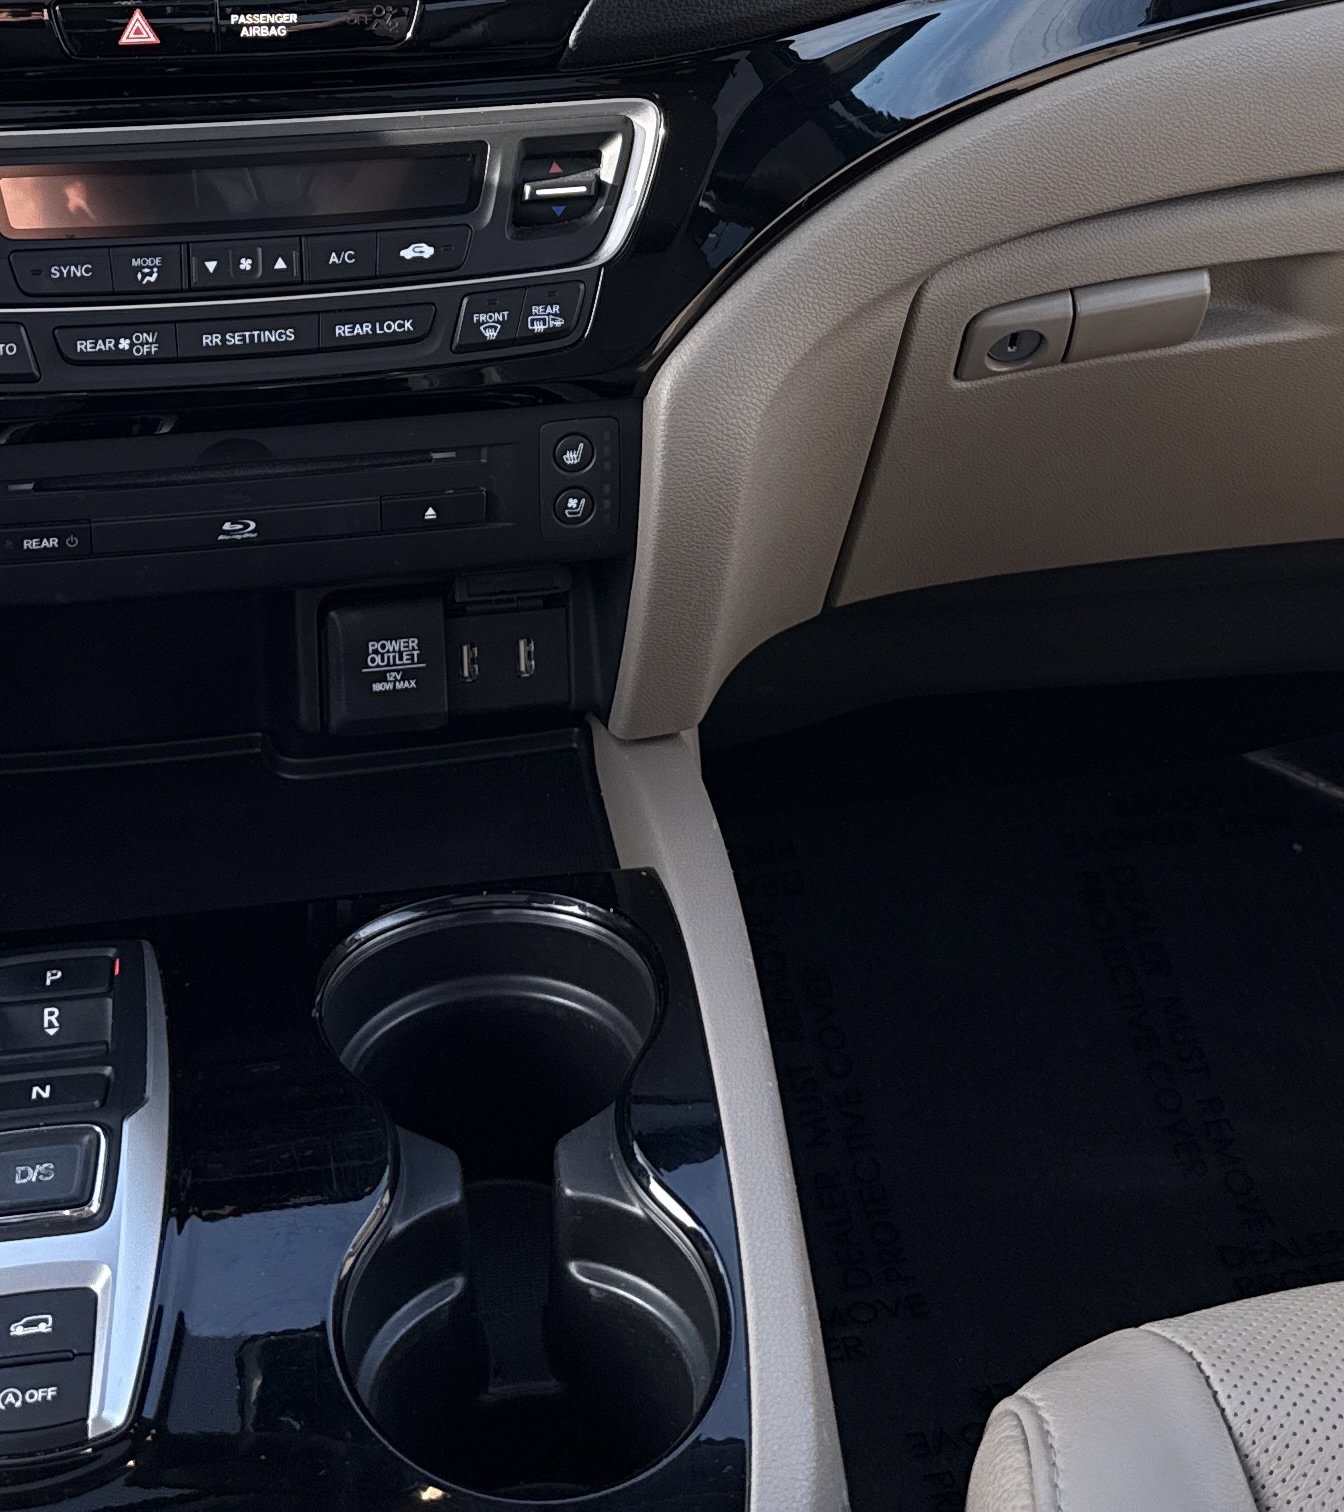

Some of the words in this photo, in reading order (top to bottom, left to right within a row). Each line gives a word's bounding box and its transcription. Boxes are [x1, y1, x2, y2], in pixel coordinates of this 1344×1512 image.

[230, 13, 298, 25] PASSENGER
[240, 25, 288, 38] AIRBAG
[131, 257, 163, 267] MODE
[328, 250, 356, 265] A/C
[50, 264, 93, 278] SYNC
[531, 304, 560, 315] REAR
[473, 311, 509, 324] FRONT
[335, 324, 373, 338] REAR
[375, 319, 414, 334] LOCK
[76, 339, 115, 352] REAR
[132, 331, 158, 344] ON/
[202, 334, 222, 347] RR
[225, 328, 295, 346] SETTINGS
[132, 343, 159, 356] OFF
[23, 537, 59, 551] REAR
[368, 637, 419, 655] POWER
[367, 650, 420, 667] OUTLET
[386, 671, 403, 681] 12V
[395, 679, 417, 690] MAX
[45, 970, 62, 986] P
[43, 1006, 60, 1028] R
[31, 1084, 51, 1100] N
[15, 1162, 55, 1184] D/S
[25, 1386, 57, 1403] OFF
